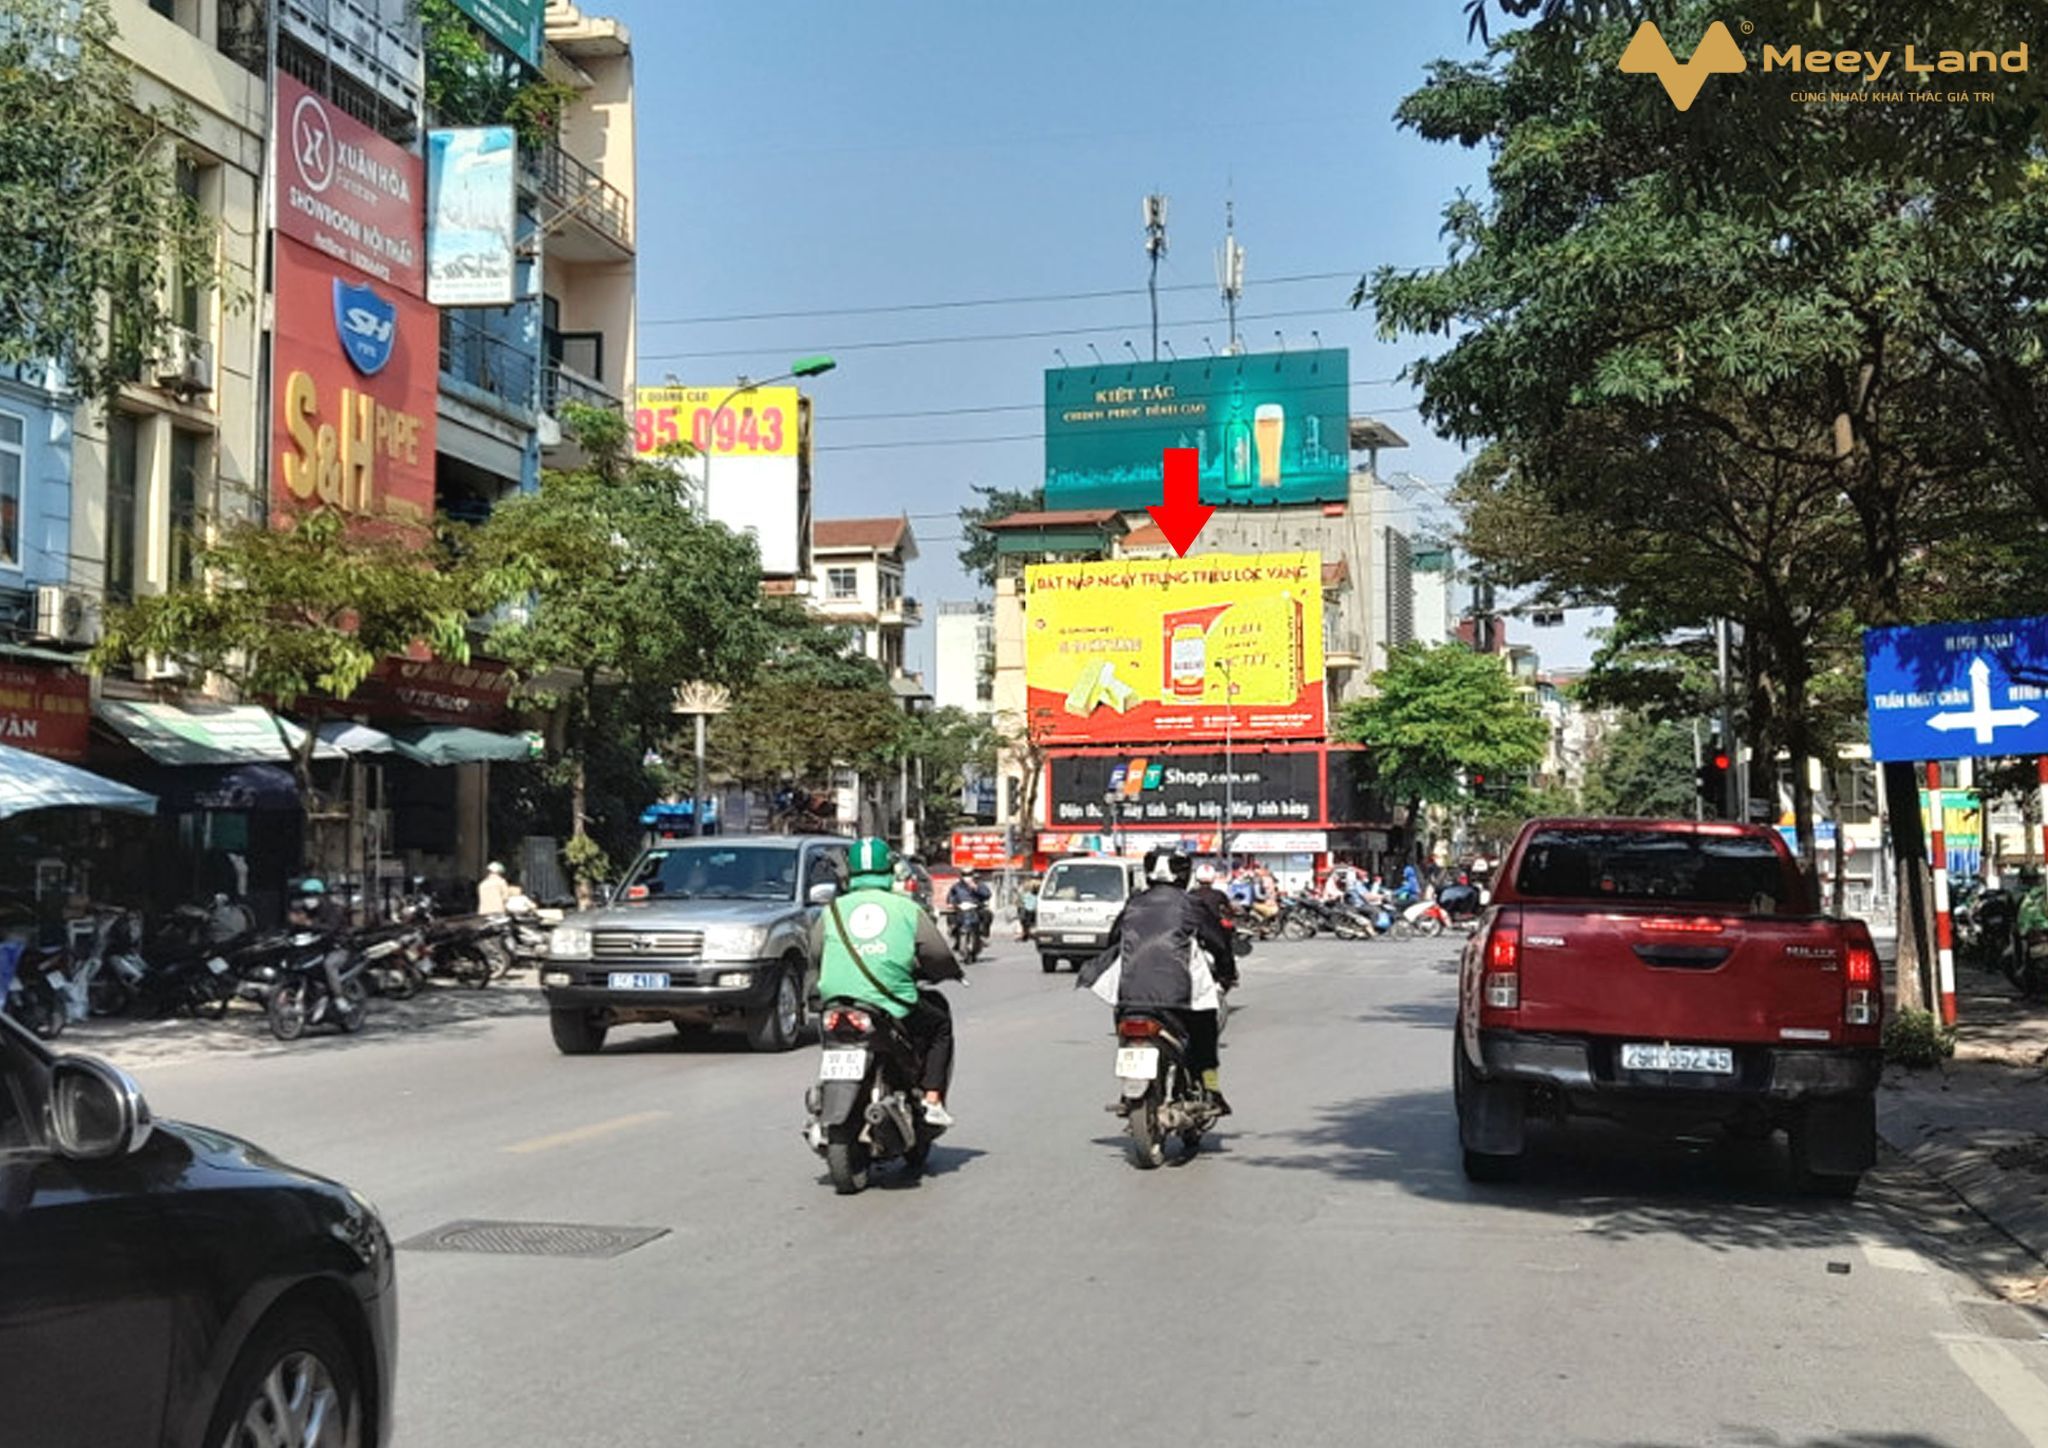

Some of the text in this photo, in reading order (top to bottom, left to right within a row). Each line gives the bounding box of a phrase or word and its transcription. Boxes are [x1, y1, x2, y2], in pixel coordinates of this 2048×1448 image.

[282, 370, 423, 518] S&H PIPE
[692, 407, 784, 452] 0943
[1107, 759, 1163, 791] FPT
